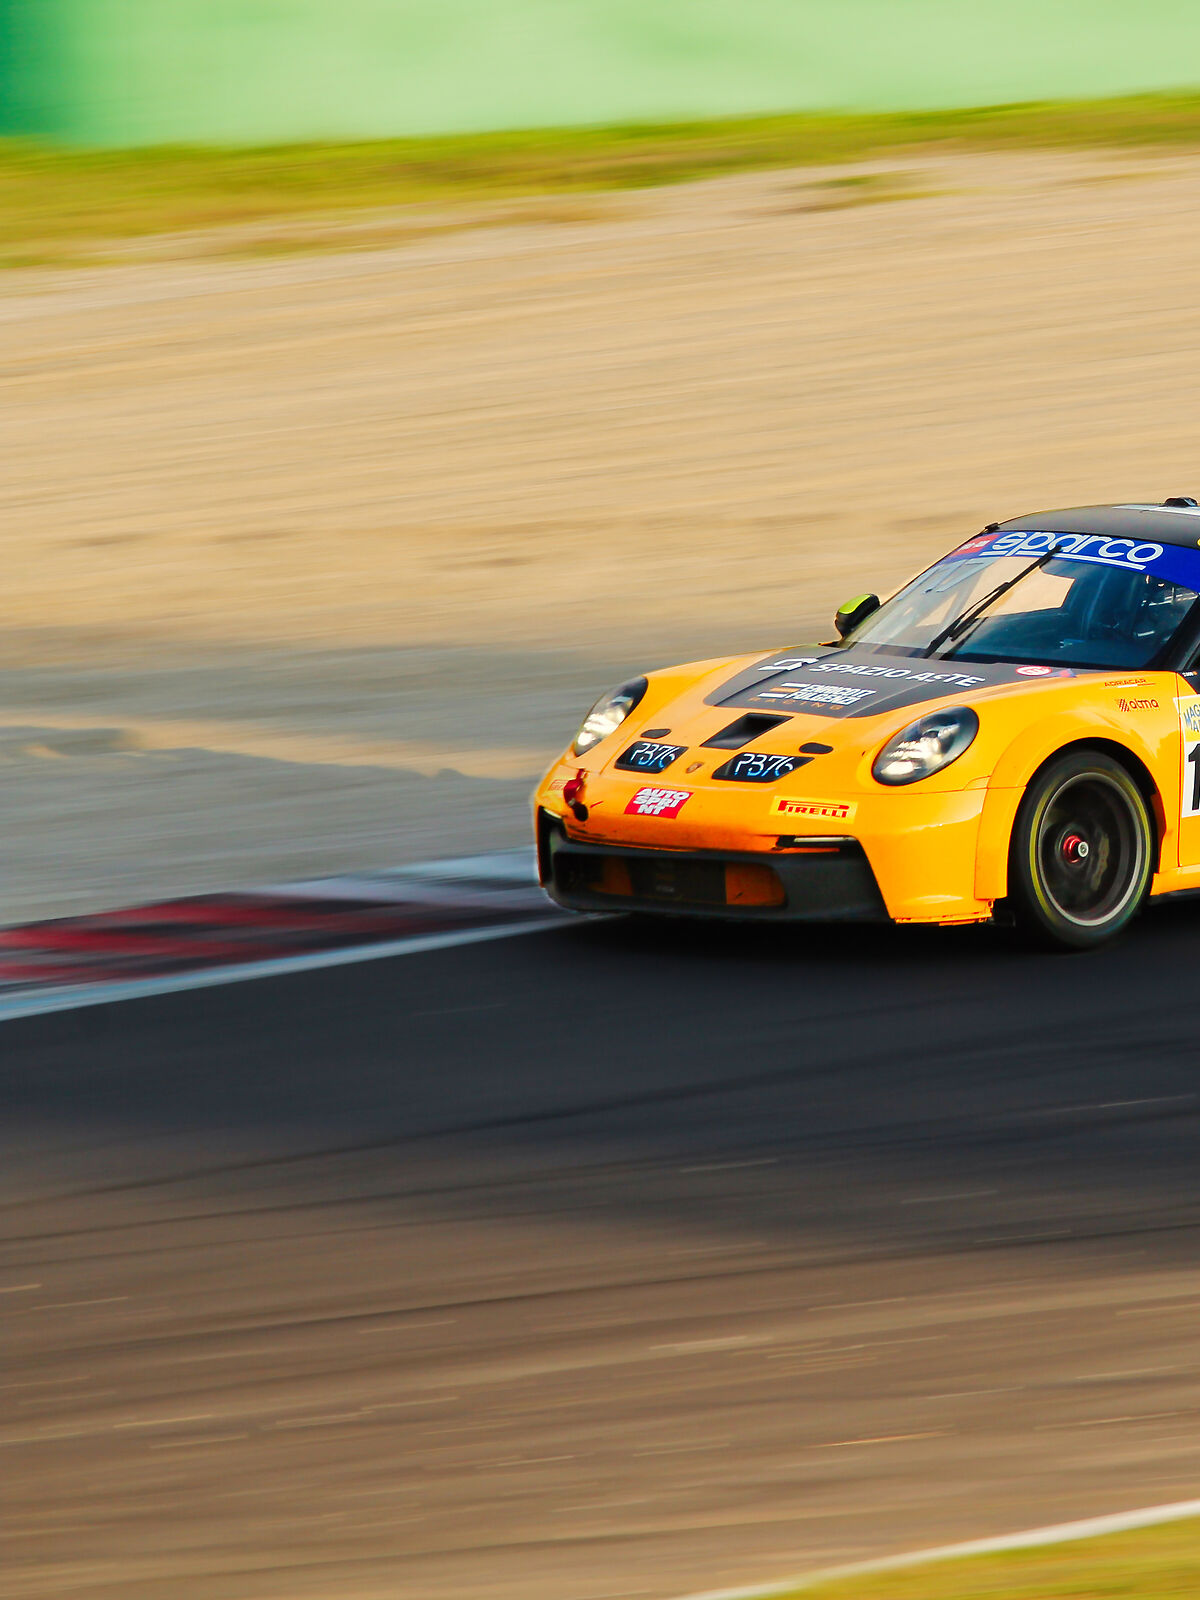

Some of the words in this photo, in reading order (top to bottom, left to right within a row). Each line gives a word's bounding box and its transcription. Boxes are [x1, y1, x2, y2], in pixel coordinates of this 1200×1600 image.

[991, 530, 1164, 564] sparco
[808, 663, 912, 679] SPAZIO
[907, 671, 986, 688] ASTE
[636, 787, 690, 800] AUTO
[633, 796, 681, 808] SPRI
[637, 804, 667, 816] NT
[778, 799, 850, 819] PIRELLI
